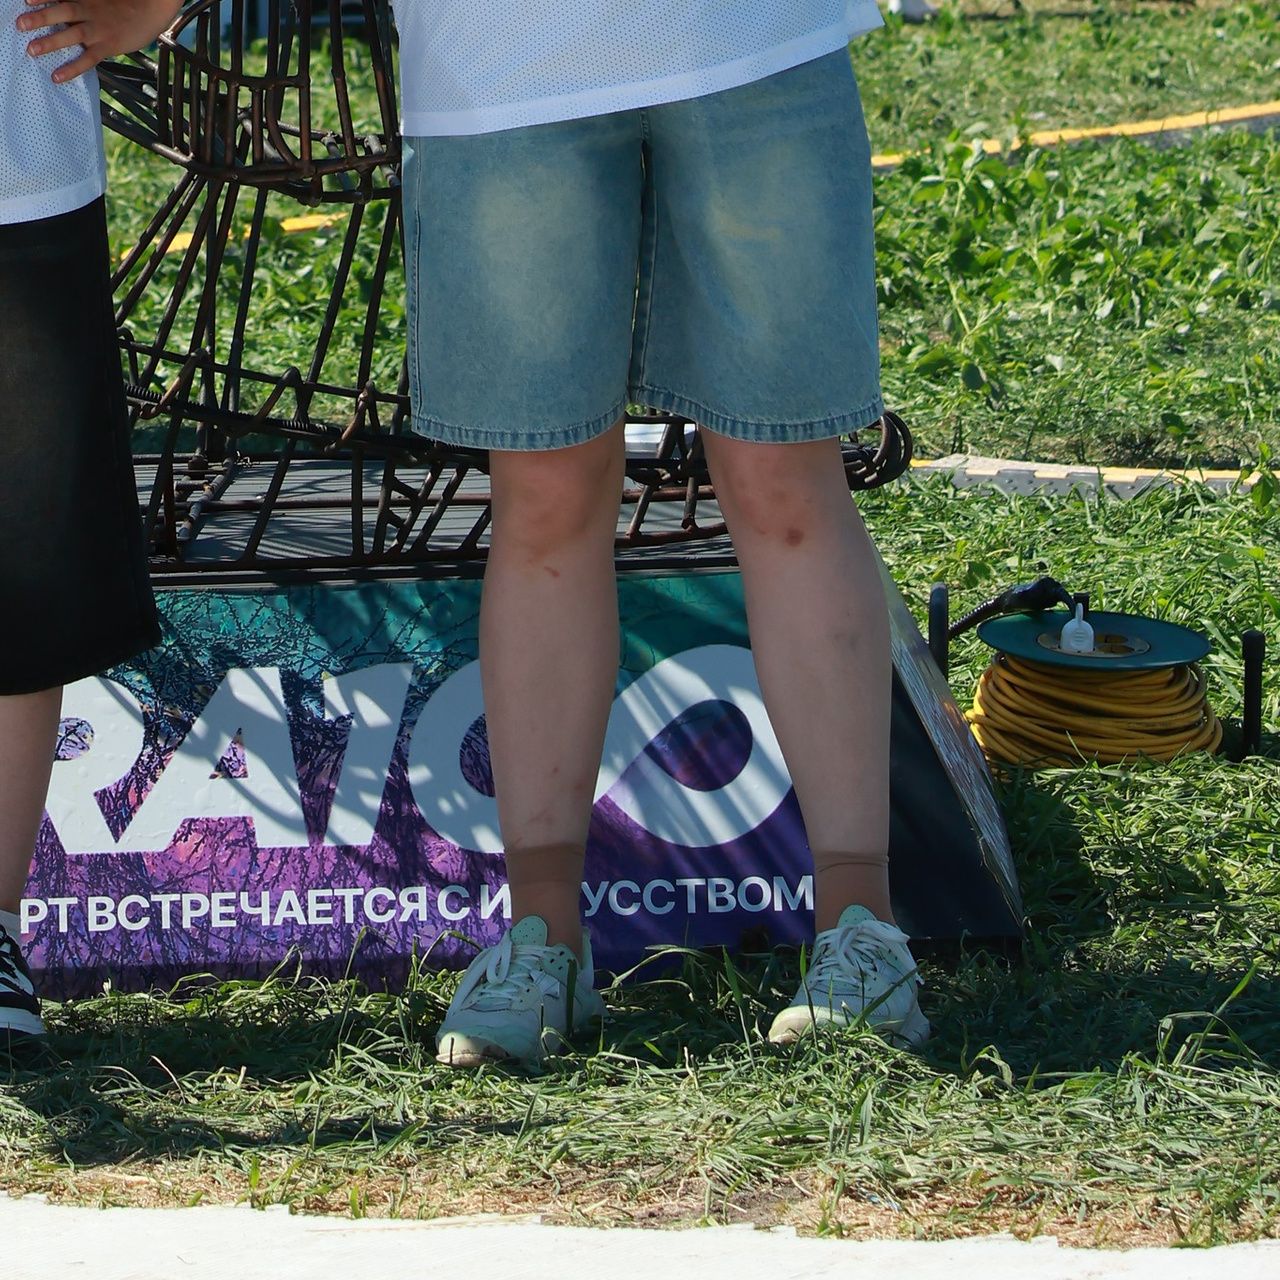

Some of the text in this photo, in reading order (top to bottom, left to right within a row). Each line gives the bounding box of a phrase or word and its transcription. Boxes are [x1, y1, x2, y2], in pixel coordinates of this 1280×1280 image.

[87, 886, 428, 932] ВСТРЕЧАЕТСЯ
[436, 884, 471, 922] С
[479, 874, 815, 922] ИУССТВОМ
